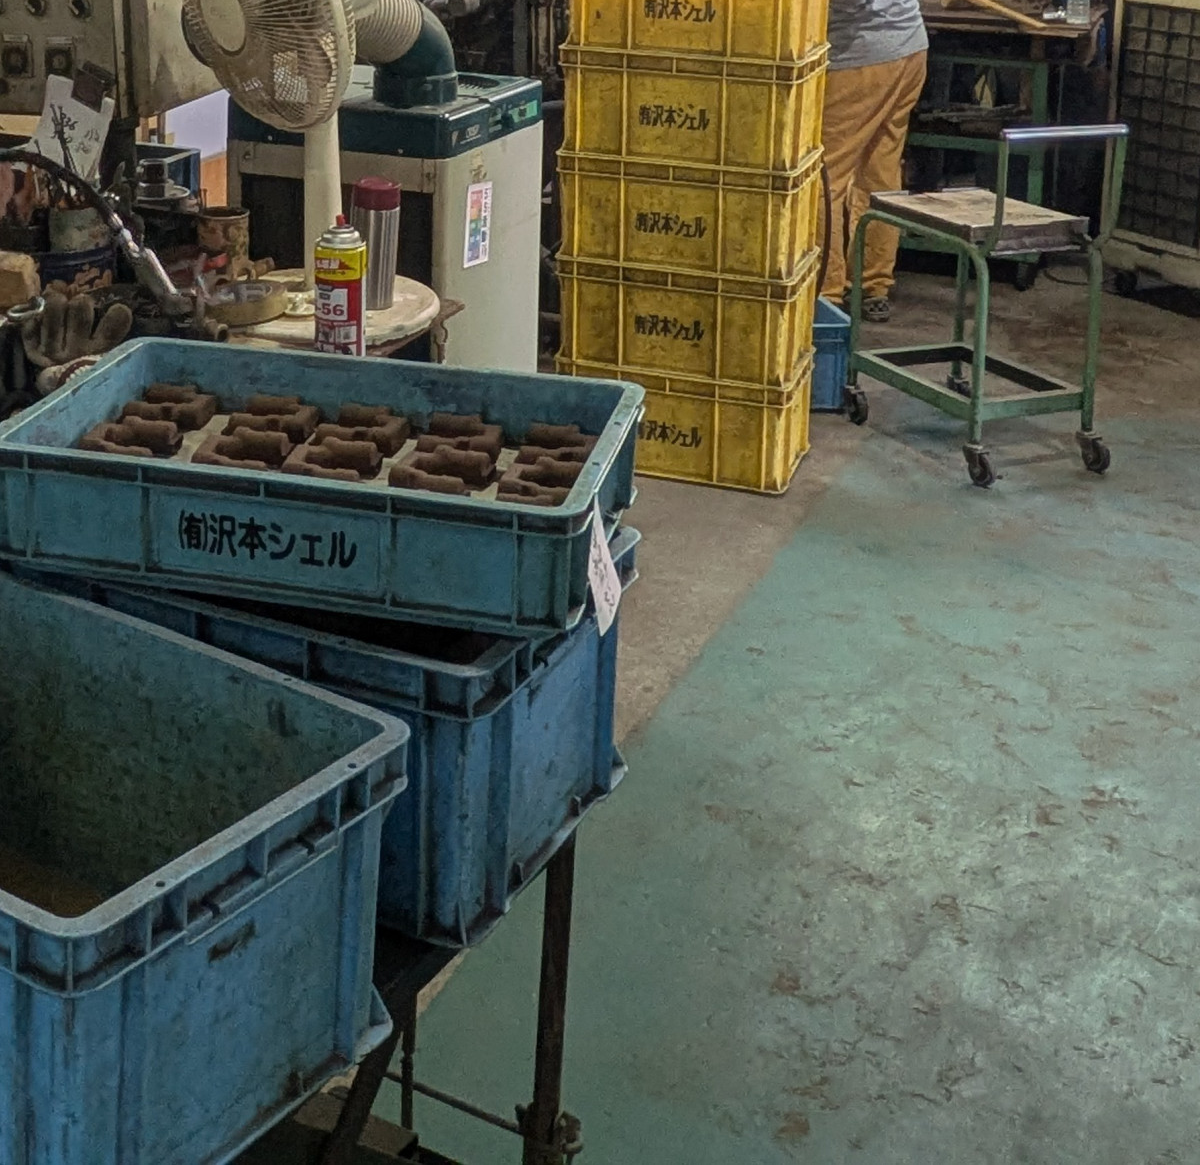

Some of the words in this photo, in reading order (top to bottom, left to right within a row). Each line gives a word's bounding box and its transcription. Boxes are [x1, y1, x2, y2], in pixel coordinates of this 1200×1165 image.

[177, 508, 358, 569] (有)沢本シェル
